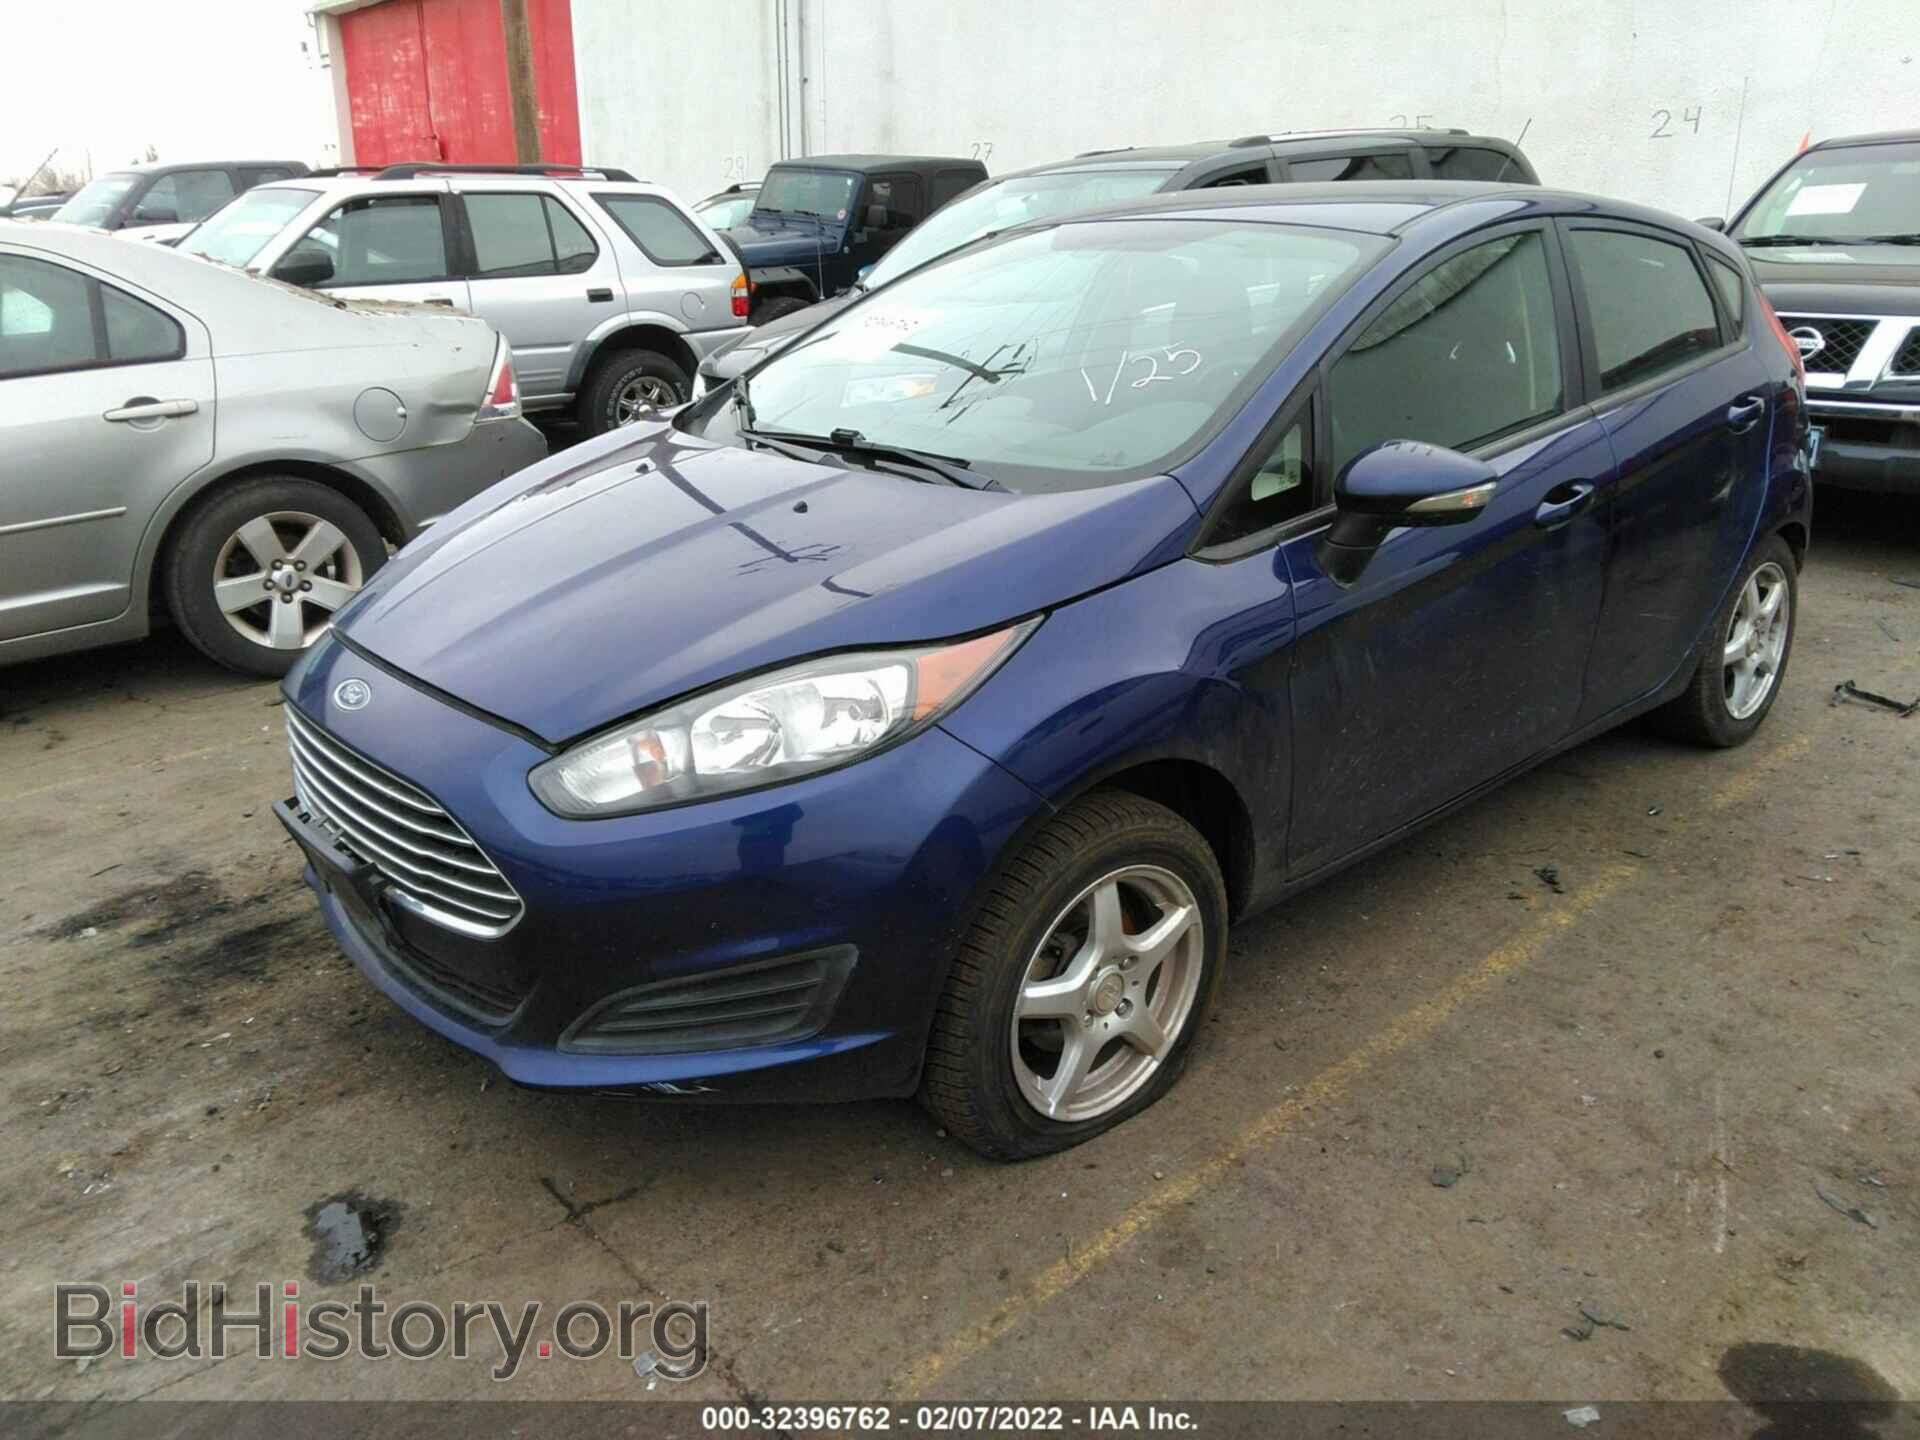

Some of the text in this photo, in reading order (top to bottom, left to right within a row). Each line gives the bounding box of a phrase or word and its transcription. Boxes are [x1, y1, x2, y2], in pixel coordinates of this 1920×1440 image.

[1649, 105, 1703, 139] 24
[970, 141, 994, 162] 27
[1080, 341, 1202, 406] 1/25
